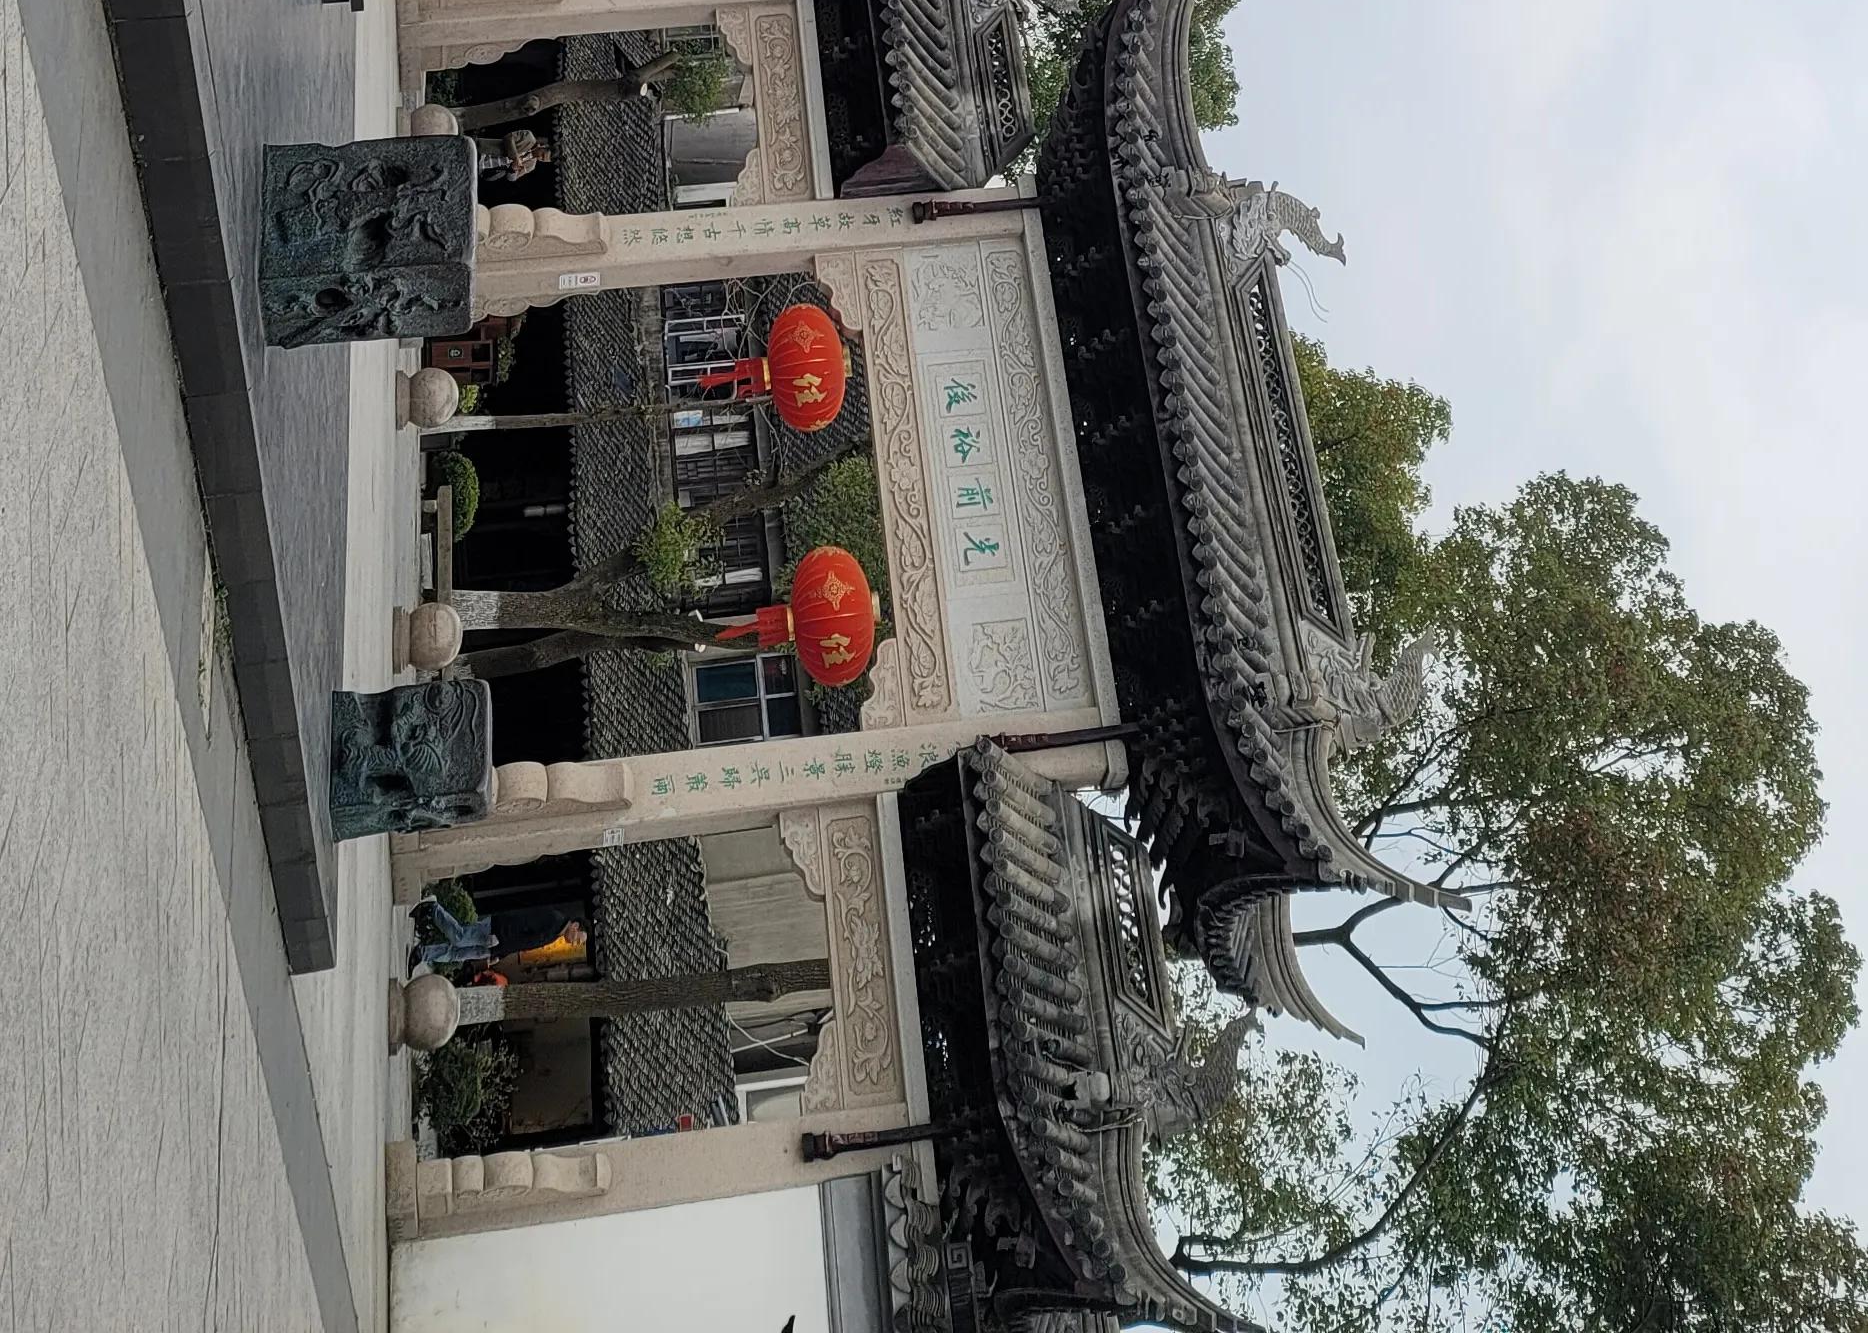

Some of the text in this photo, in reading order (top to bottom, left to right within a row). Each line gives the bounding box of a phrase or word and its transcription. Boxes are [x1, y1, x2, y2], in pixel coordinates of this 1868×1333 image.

[792, 373, 827, 407] 佳
[943, 377, 1000, 567] 光前裕後
[819, 633, 856, 669] 佳
